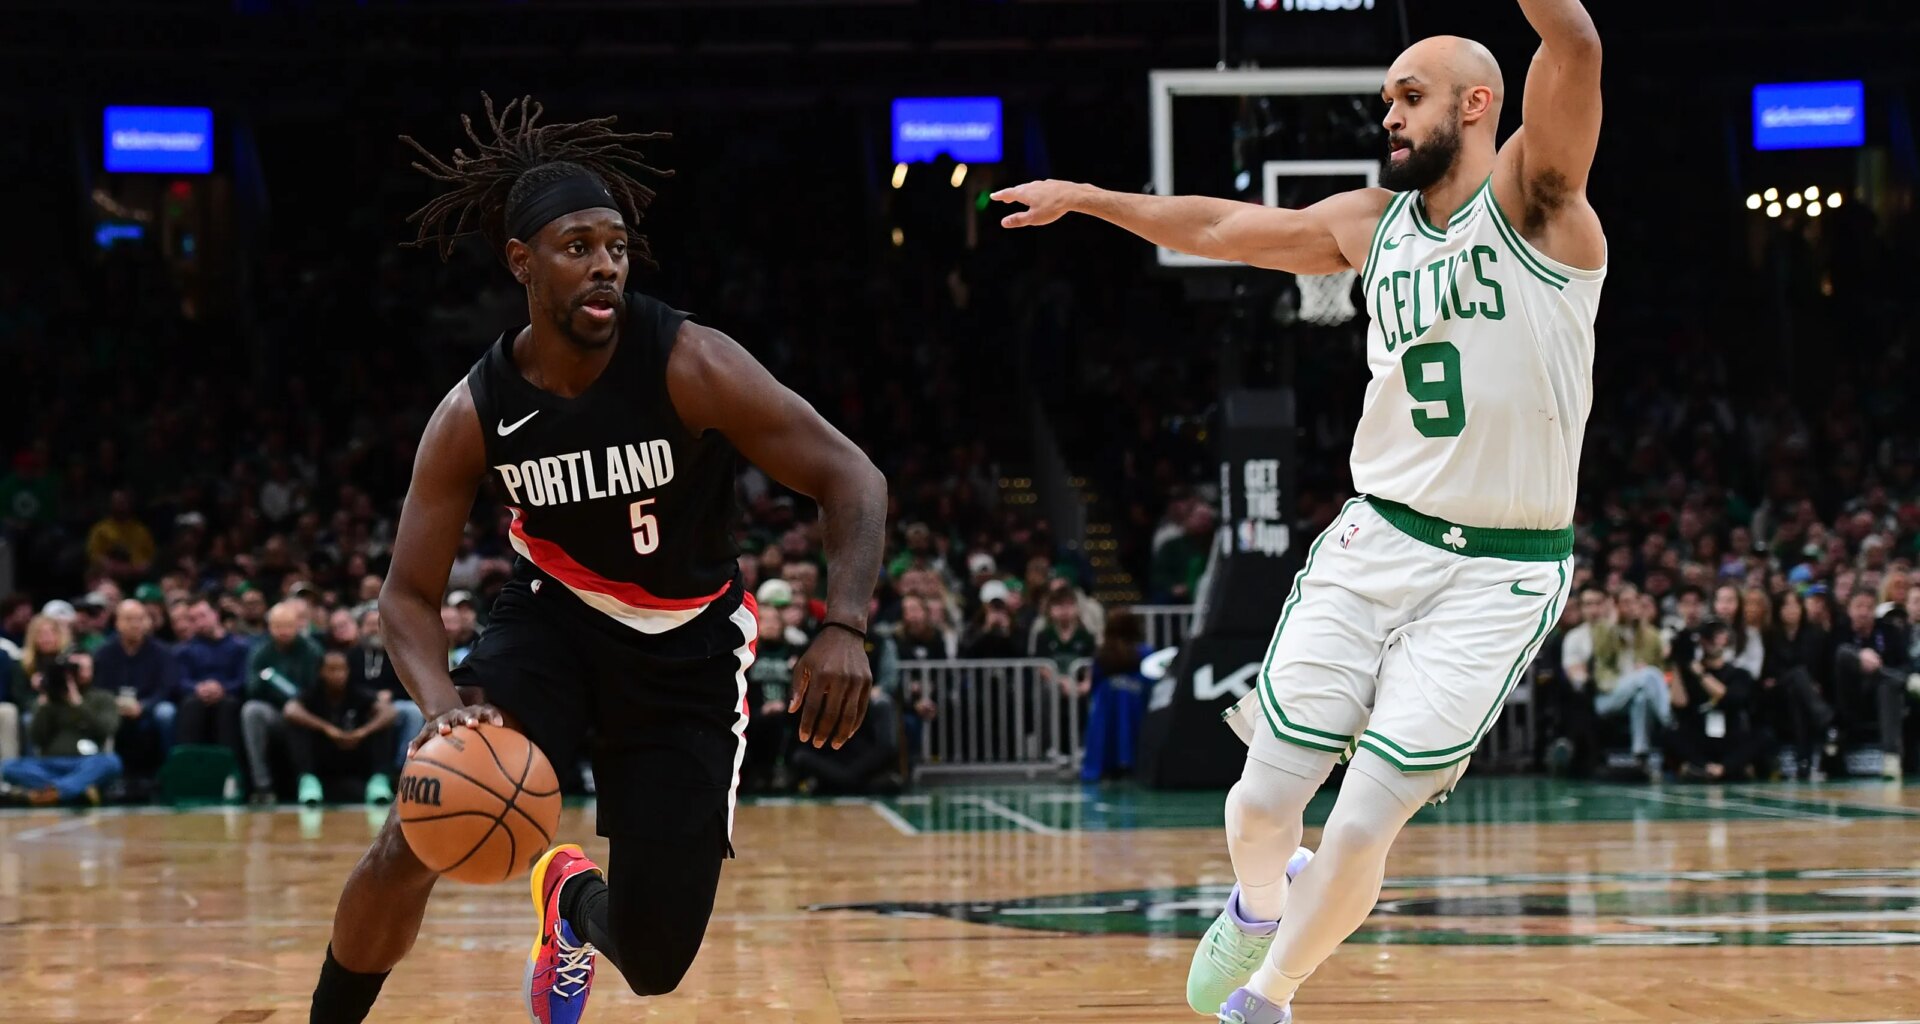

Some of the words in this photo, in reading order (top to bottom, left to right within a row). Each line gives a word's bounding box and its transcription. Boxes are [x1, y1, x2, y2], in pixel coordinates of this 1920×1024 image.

[1376, 244, 1506, 353] CELTICS
[1401, 341, 1466, 438] 9
[494, 439, 674, 507] PORTLAND
[629, 497, 660, 555] 5
